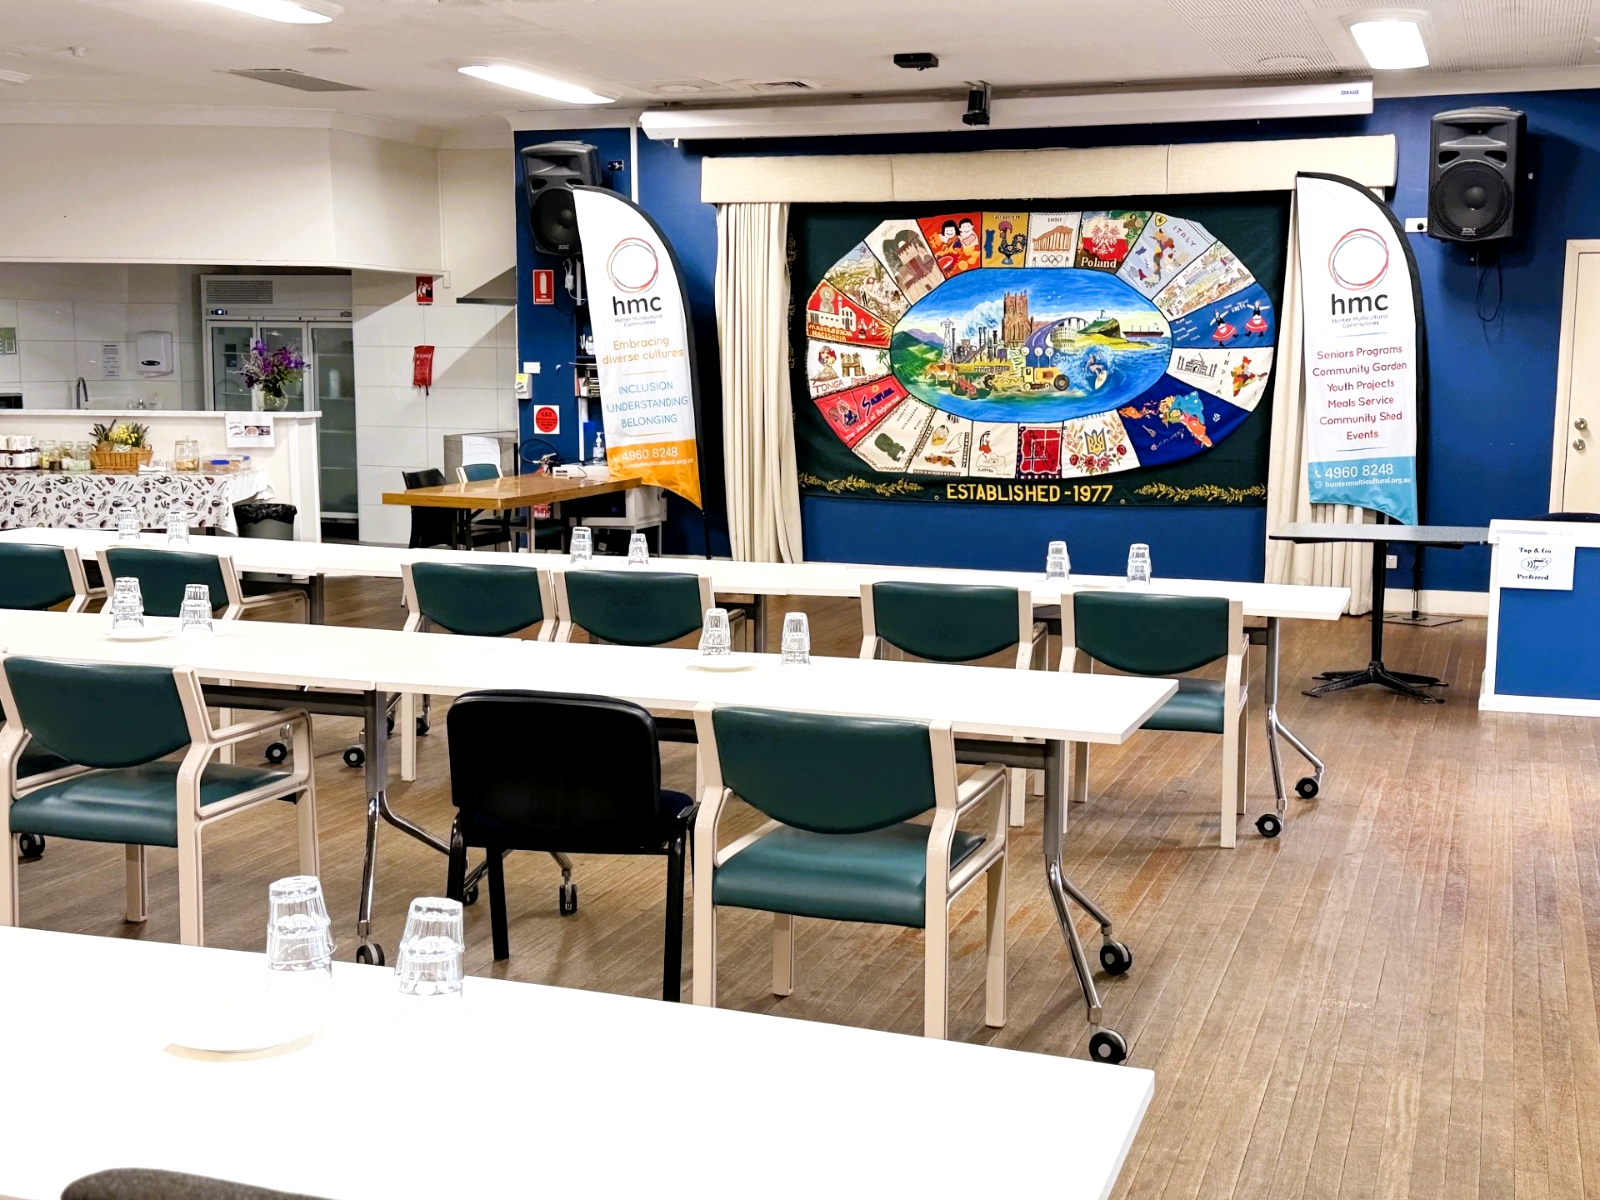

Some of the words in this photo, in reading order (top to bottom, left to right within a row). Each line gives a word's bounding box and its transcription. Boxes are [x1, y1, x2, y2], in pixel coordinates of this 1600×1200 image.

[1172, 225, 1197, 247] ITALY
[1081, 257, 1117, 268] Poland
[612, 296, 662, 315] hmc
[1331, 293, 1388, 315] hmc
[1352, 313, 1389, 322] Multicultural
[613, 337, 669, 350] Embracing
[602, 353, 639, 365] diverse
[642, 349, 684, 360] cultures
[1317, 350, 1354, 360] Seniors
[1356, 346, 1403, 357] Programs
[1216, 351, 1231, 395] INDIA
[1312, 364, 1370, 377] Community
[1372, 361, 1407, 372] Garden
[618, 381, 674, 395] INCLUSION
[812, 379, 845, 394] TONGA
[1327, 382, 1354, 392] Youth
[1356, 379, 1394, 390] Projects
[606, 396, 689, 413] UNDERSTANDING
[1328, 398, 1356, 409] Meals
[1358, 396, 1394, 406] Service
[621, 413, 678, 428] BELONGING
[1319, 413, 1376, 425] Community
[1379, 411, 1403, 421] Shed
[1346, 429, 1379, 440] Events
[622, 448, 649, 461] 4960
[652, 446, 678, 458] 8248
[1324, 466, 1358, 479] 4960
[1362, 463, 1394, 476] 8248
[1325, 476, 1411, 488] huntermulticultural.org.au
[1517, 573, 1549, 581] Preferred
